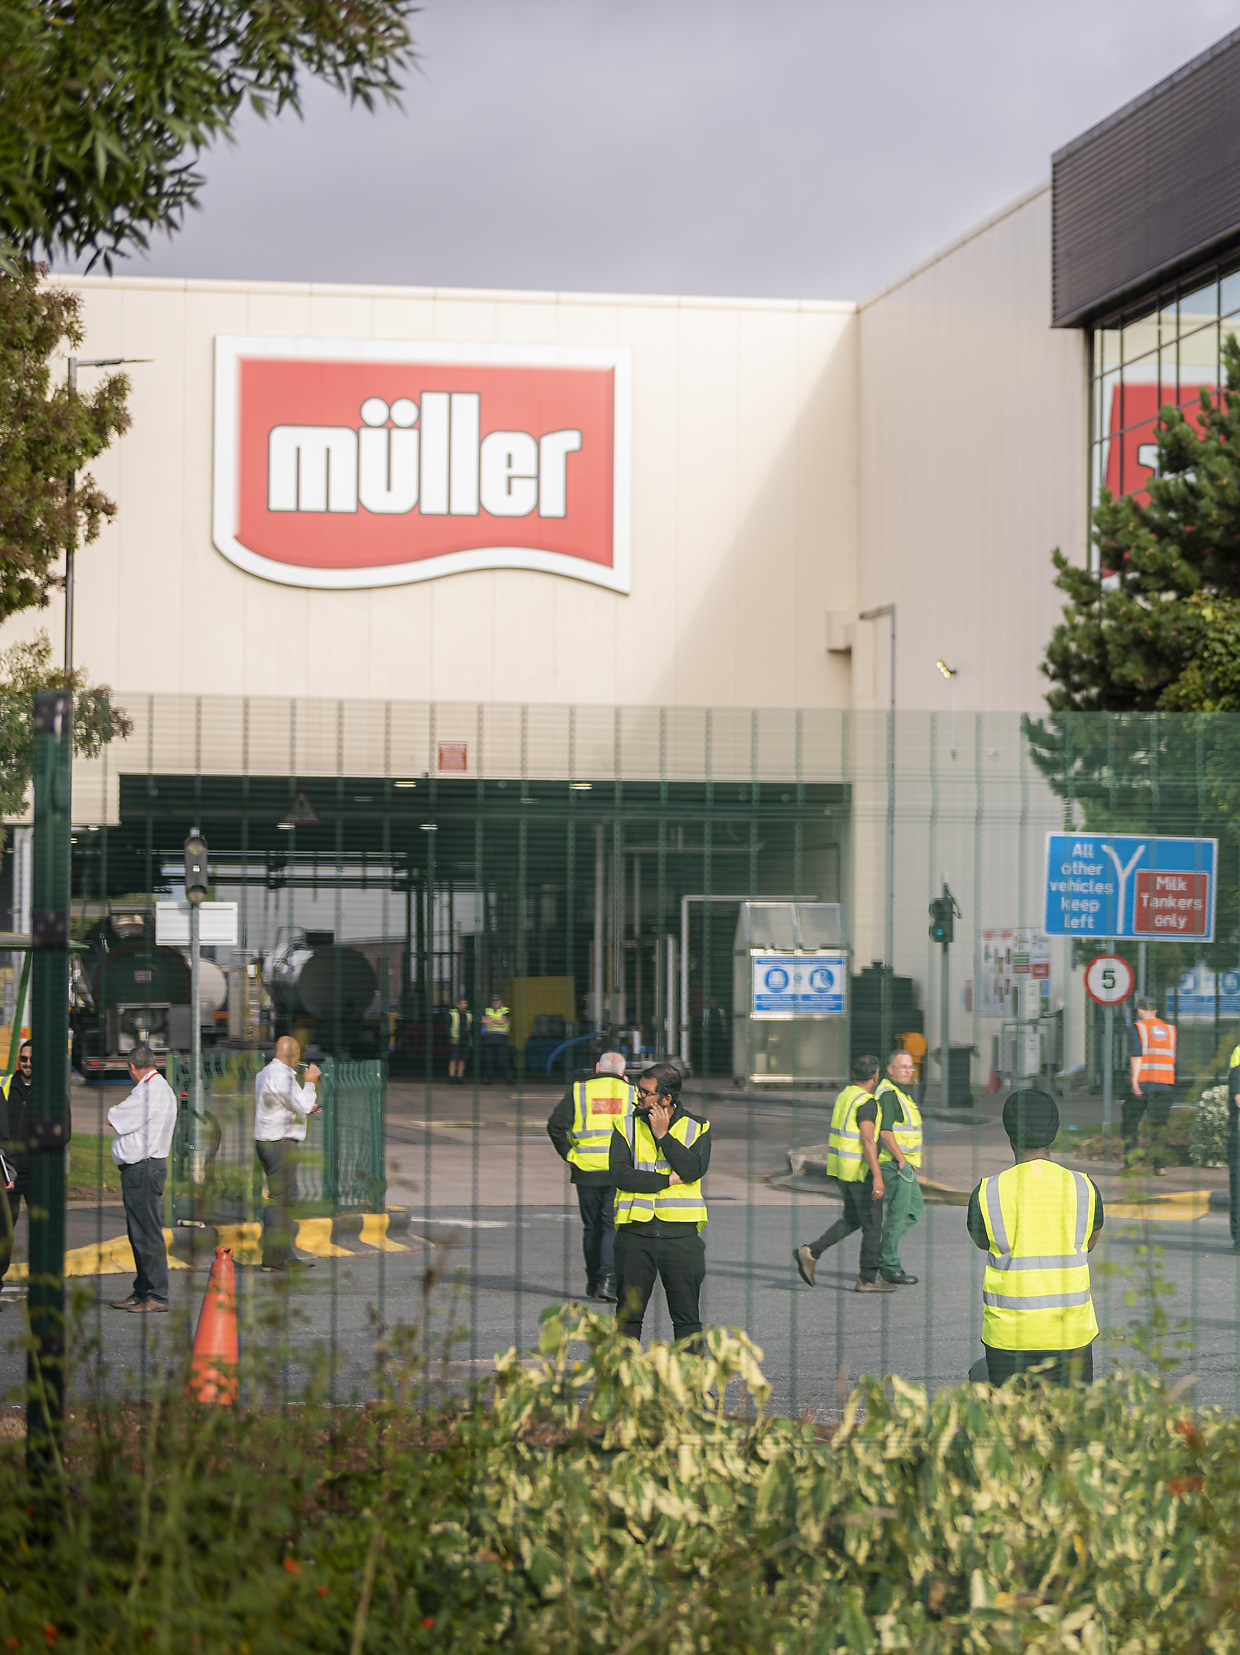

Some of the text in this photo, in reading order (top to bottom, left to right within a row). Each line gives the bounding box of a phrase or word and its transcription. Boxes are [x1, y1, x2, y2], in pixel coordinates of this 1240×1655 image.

[267, 390, 582, 518] müller
[1072, 843, 1095, 859] All
[1061, 861, 1104, 876] other
[1050, 878, 1114, 894] vehicles
[1156, 876, 1187, 891] Milk
[1061, 897, 1100, 914] keep
[1140, 893, 1203, 910] Tankers
[1064, 914, 1095, 929] left
[1155, 914, 1187, 930] only
[1102, 970, 1116, 989] 5
